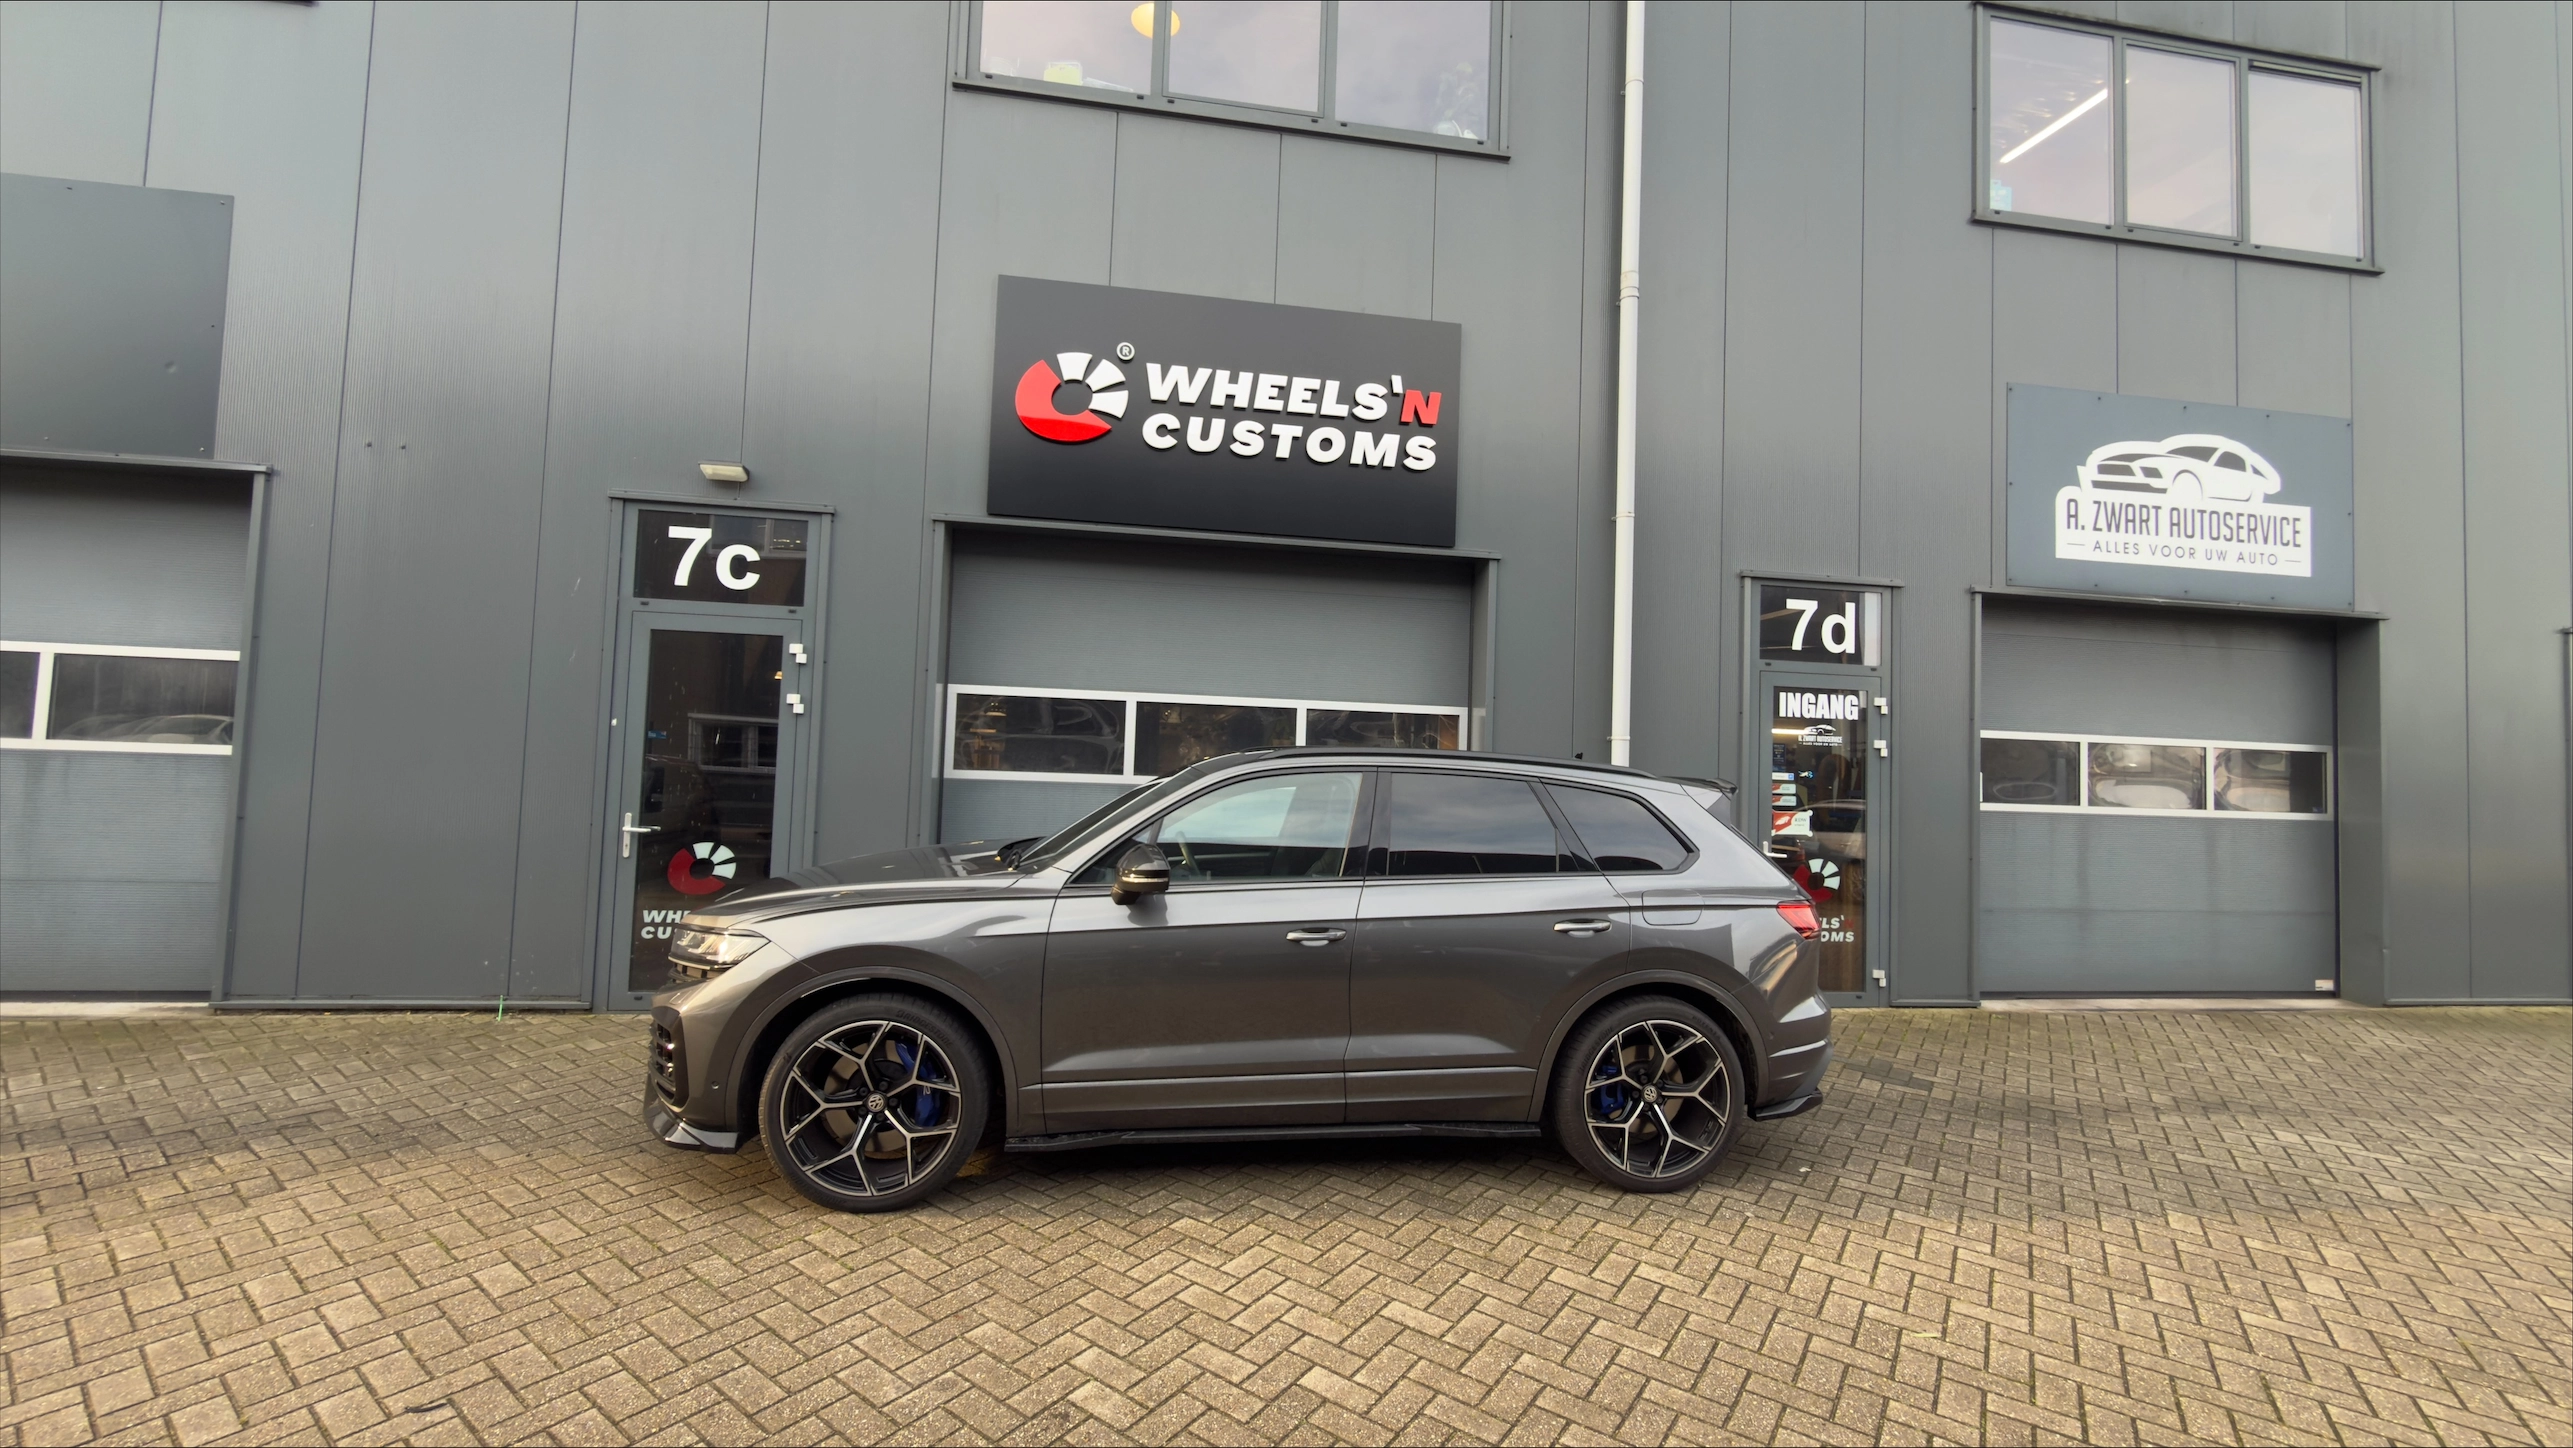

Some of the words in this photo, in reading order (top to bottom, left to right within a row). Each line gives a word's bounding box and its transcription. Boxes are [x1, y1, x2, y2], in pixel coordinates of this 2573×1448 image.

[1141, 412, 1437, 471] CUSTOMS
[2066, 498, 2086, 531] A.
[2092, 500, 2162, 536] ZWART
[2169, 506, 2302, 548] AUTOSERVICE
[668, 525, 761, 590] 7c
[2093, 540, 2140, 555] ALLES
[2149, 544, 2196, 560] VOOR
[2205, 549, 2228, 562] UW
[2236, 551, 2278, 566] AUTO
[1786, 598, 1856, 654] 7d
[1779, 692, 1859, 721] INGANG
[641, 926, 677, 939] CU
